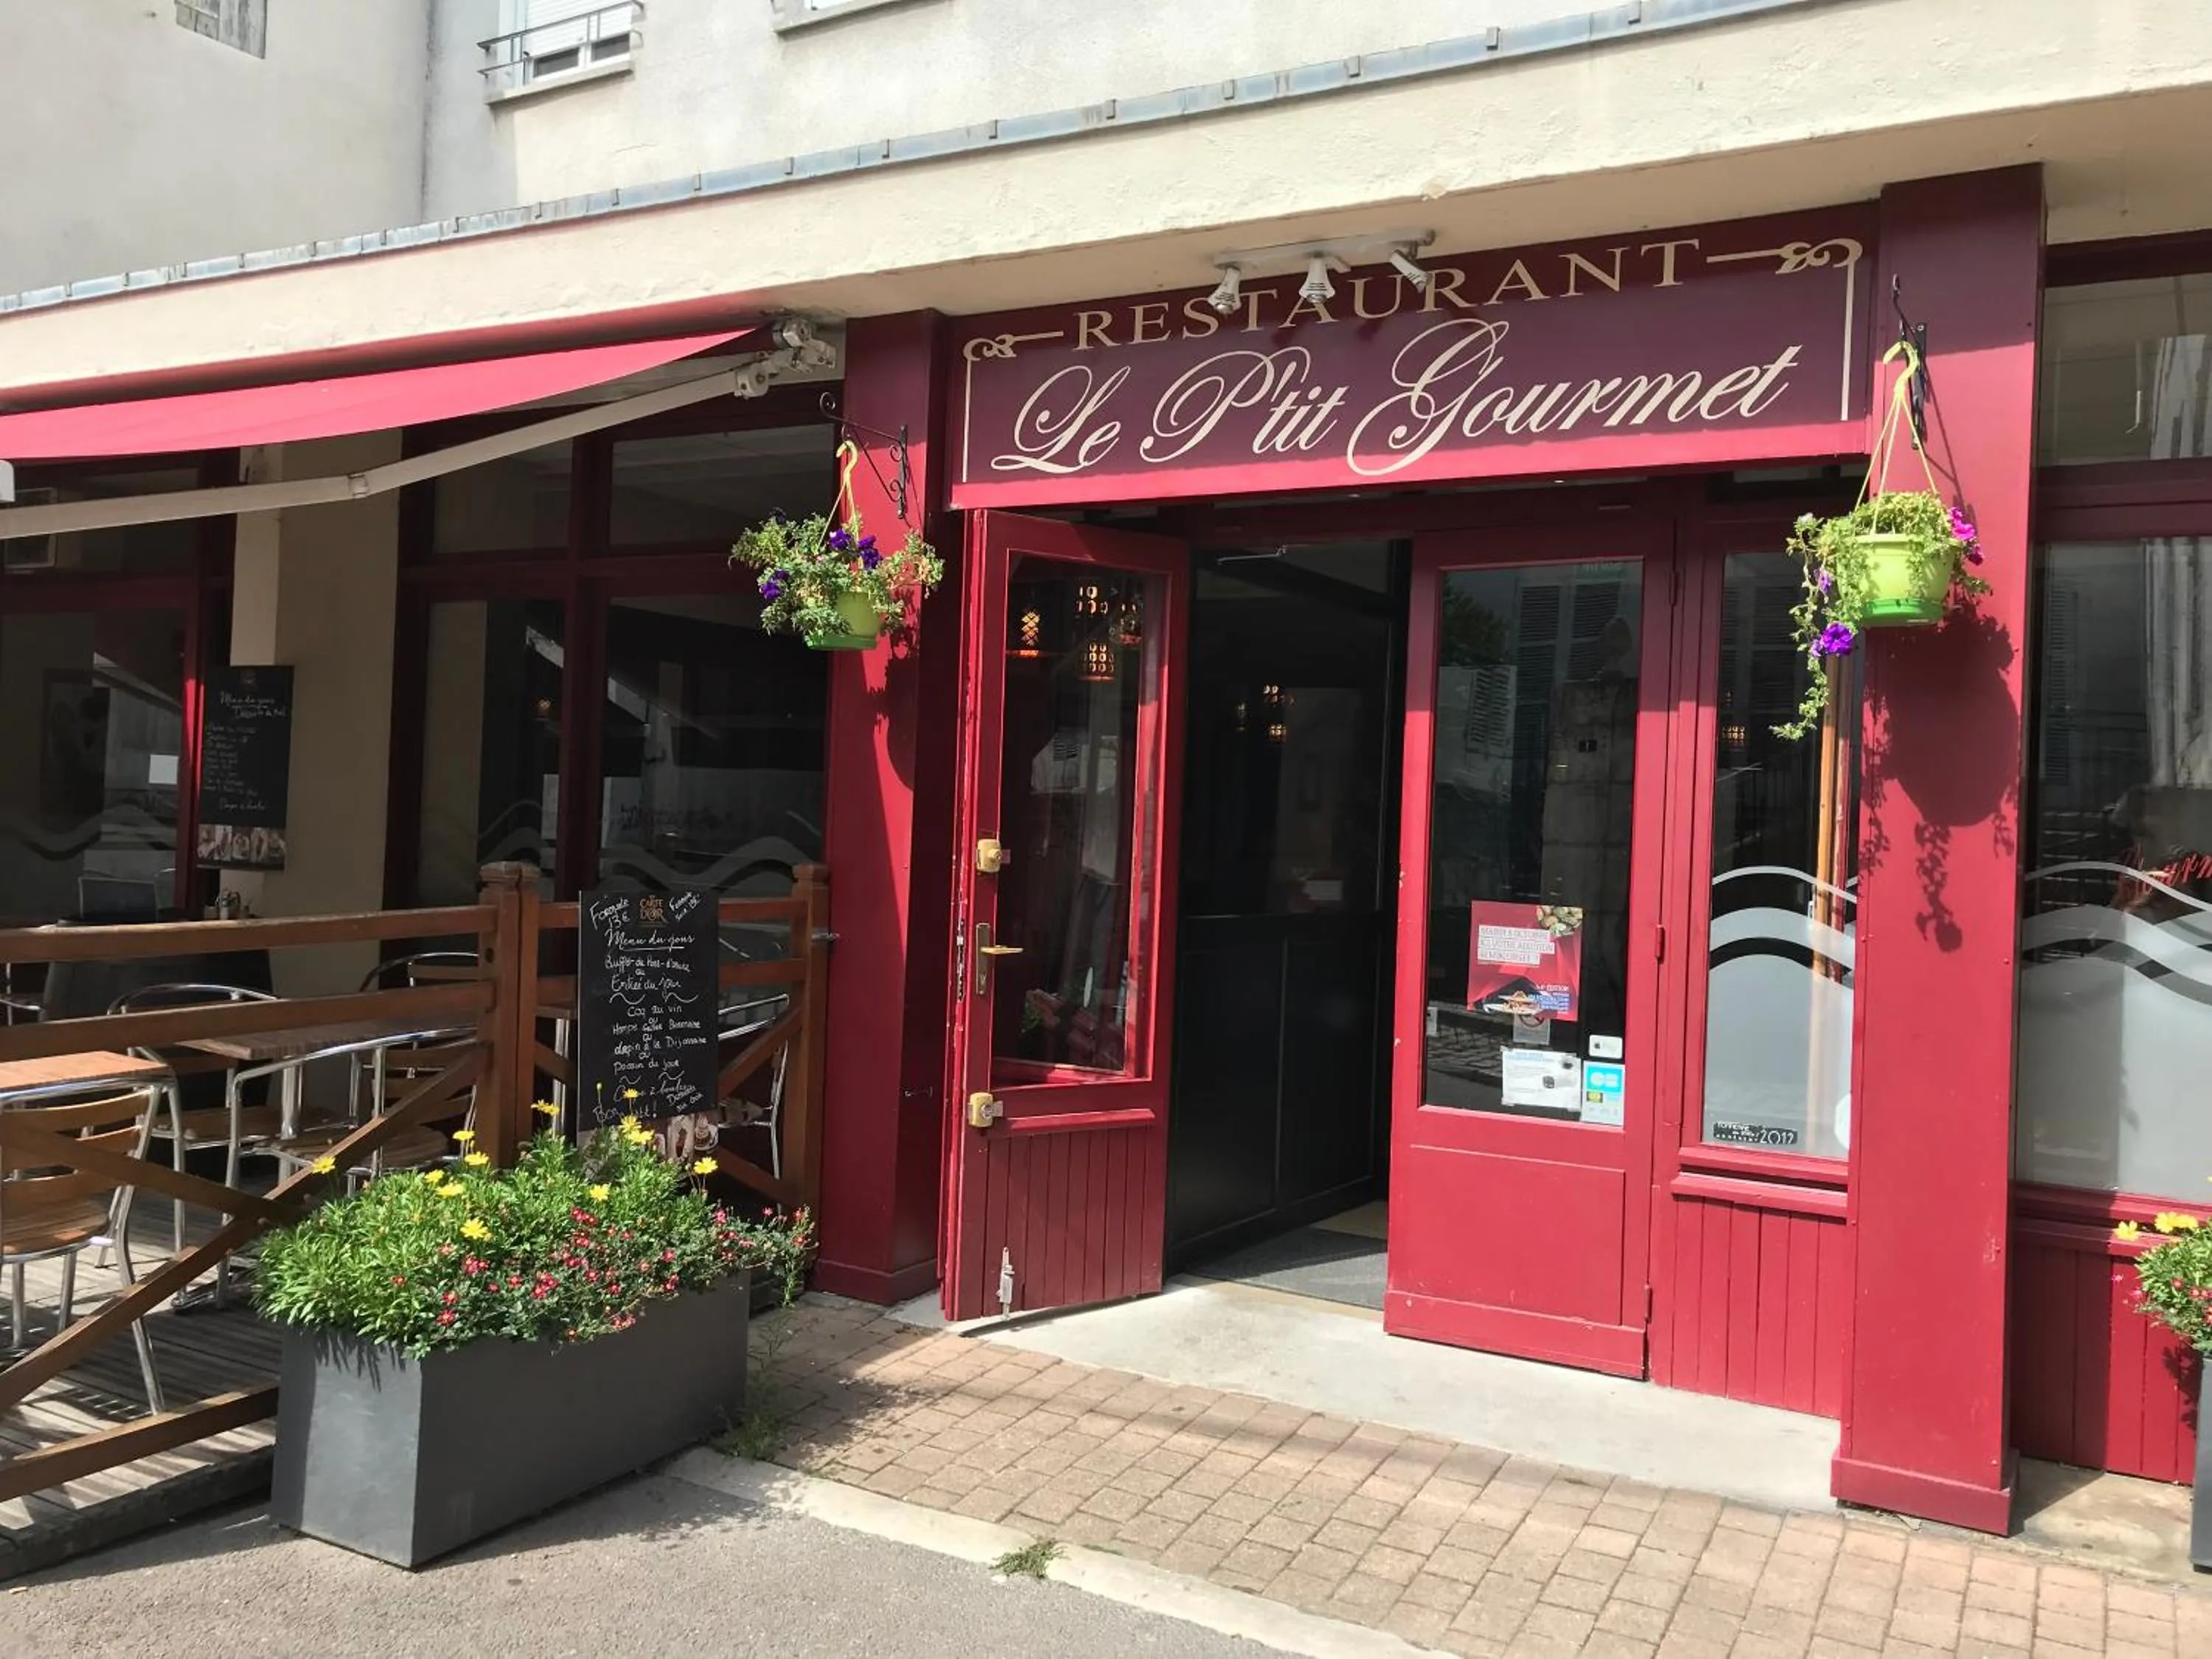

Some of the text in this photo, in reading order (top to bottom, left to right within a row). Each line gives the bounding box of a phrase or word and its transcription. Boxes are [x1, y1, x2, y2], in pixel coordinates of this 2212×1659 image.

[1073, 238, 1700, 351] RESTAURANT
[991, 318, 1803, 476] Le P'tit Gourmet
[639, 898, 664, 908] CARTE
[605, 930, 645, 950] Menu
[649, 929, 664, 945] du
